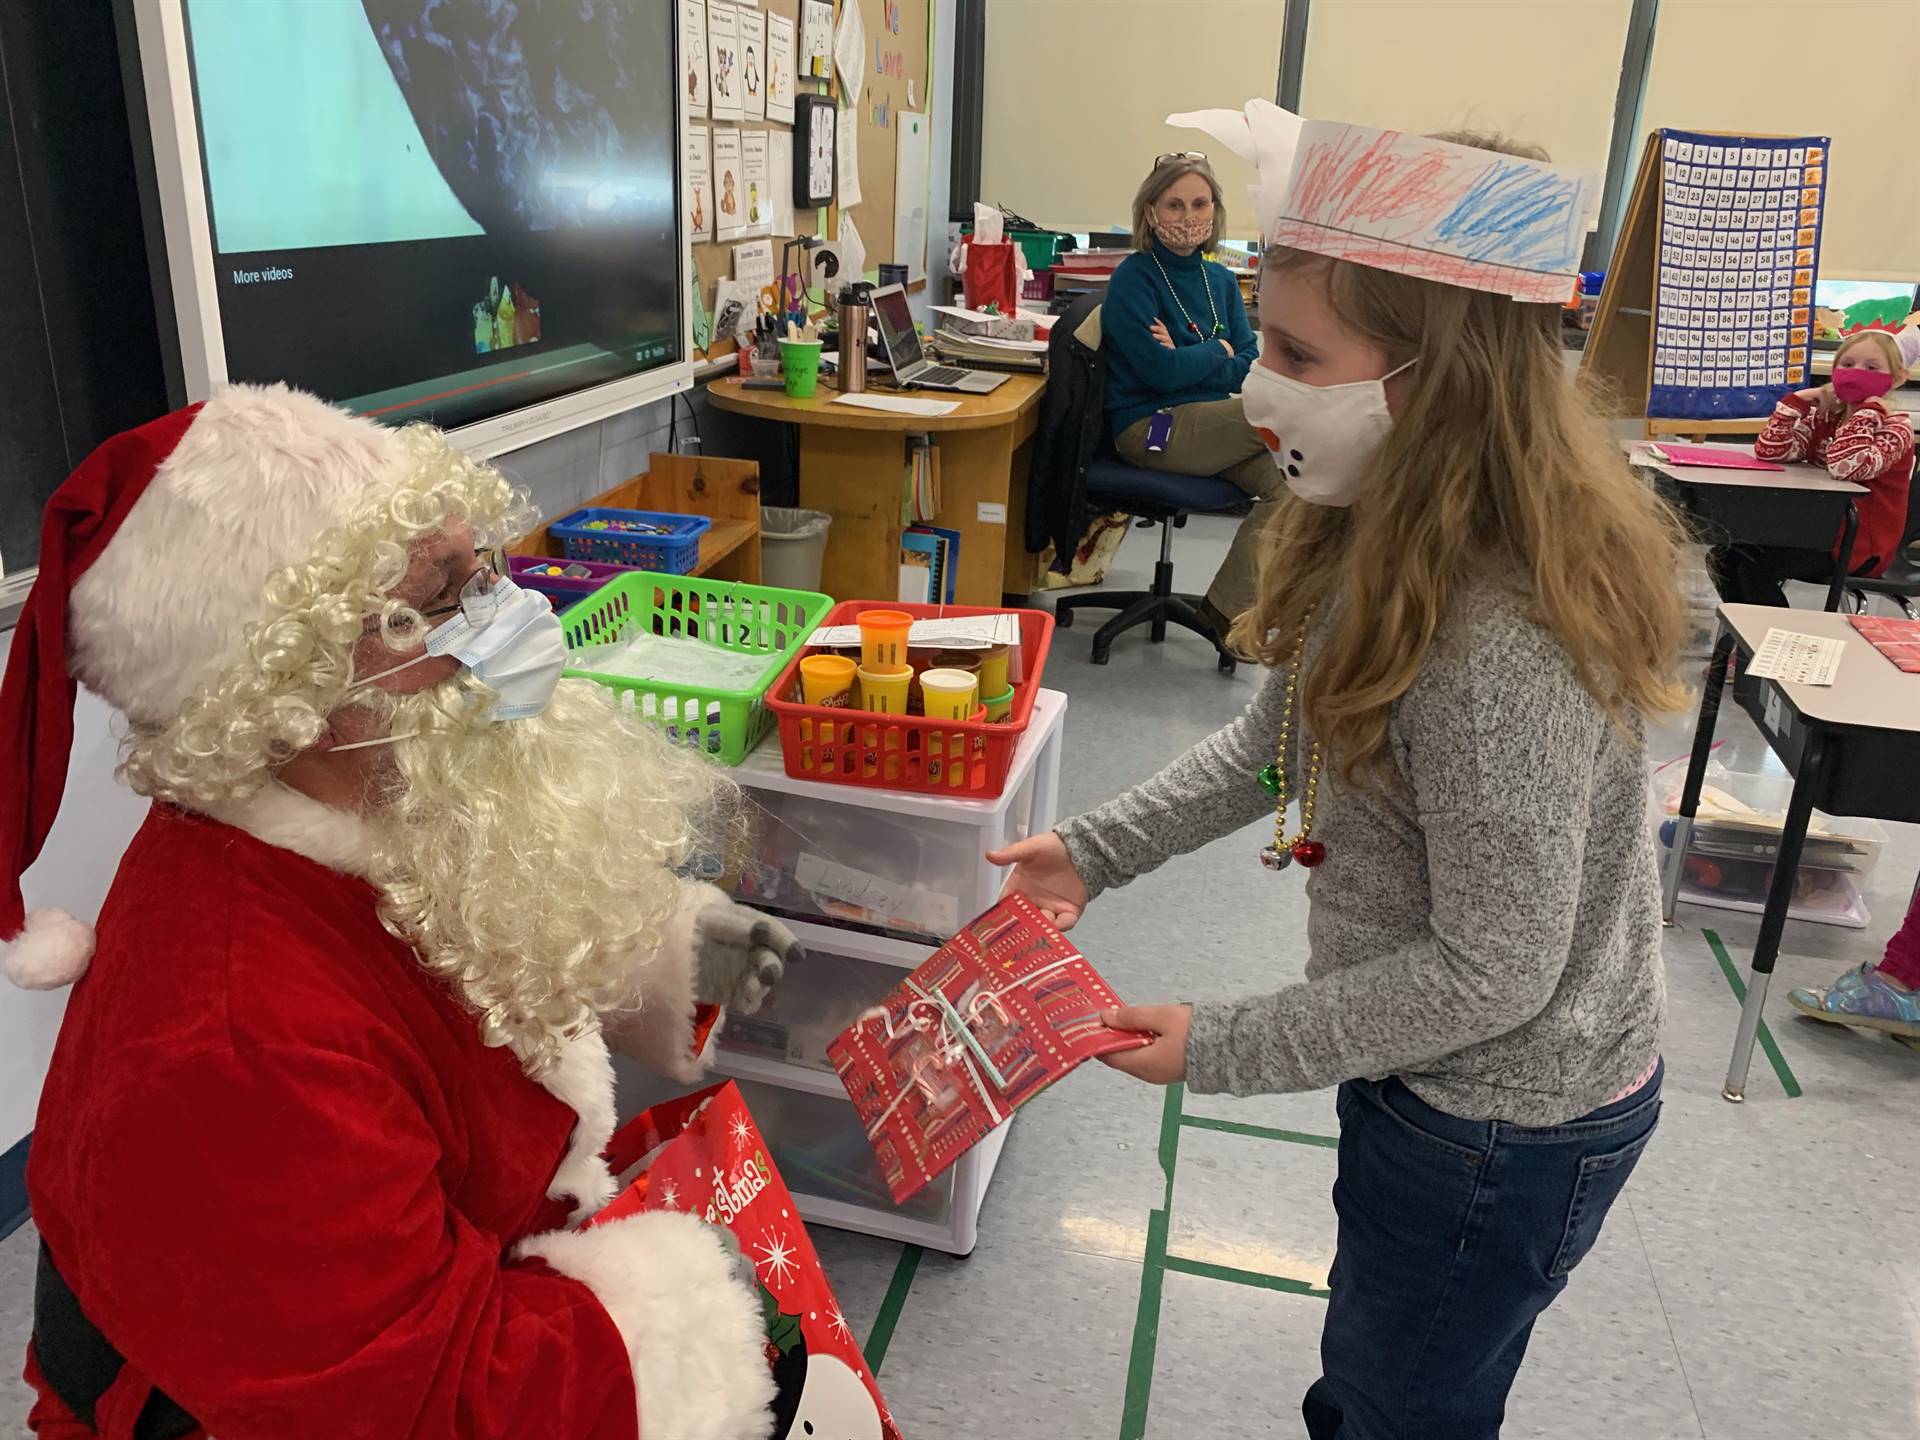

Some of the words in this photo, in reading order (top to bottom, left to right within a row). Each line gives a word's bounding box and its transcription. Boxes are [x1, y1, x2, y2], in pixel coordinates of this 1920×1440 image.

[1698, 150, 1703, 158] 3
[1730, 152, 1734, 160] 5
[1679, 169, 1686, 178] 12
[1694, 172, 1702, 180] 13
[1726, 174, 1732, 182] 15
[1758, 174, 1766, 183] 17
[1774, 174, 1781, 182] 18
[1807, 172, 1816, 182] 2
[1677, 190, 1686, 199] 22
[1690, 192, 1700, 201] 23
[1706, 193, 1715, 202] 24
[1721, 194, 1730, 203] 25
[1737, 196, 1746, 204] 26
[1752, 196, 1762, 204] 27
[1768, 195, 1777, 204] 28
[1785, 194, 1796, 202] 29
[1675, 211, 1683, 220] 32
[1688, 213, 1696, 221] 33
[1702, 214, 1712, 222] 34
[1718, 215, 1727, 224] 35
[1733, 215, 1742, 223] 36
[1750, 216, 1760, 224] 37
[1765, 215, 1774, 223] 38
[1782, 214, 1793, 223] 39
[1674, 231, 1682, 240] 42
[1686, 234, 1695, 242] 43
[1715, 236, 1724, 244] 45
[1762, 235, 1772, 243] 48
[1780, 234, 1791, 242] 49
[1672, 251, 1680, 260] 52
[1684, 253, 1693, 262] 53
[1698, 254, 1707, 262] 54
[1713, 256, 1722, 264] 55
[1728, 256, 1737, 264] 56
[1744, 256, 1753, 264] 57
[1760, 255, 1770, 264] 58
[1779, 254, 1790, 263] 59
[233, 270, 260, 284] More
[262, 266, 293, 281] videos
[1672, 273, 1678, 281] 62
[1682, 274, 1690, 282] 63
[1710, 275, 1720, 283] 65
[1742, 275, 1751, 283] 67
[1758, 274, 1768, 283] 68
[1777, 274, 1788, 282] 69
[1798, 272, 1809, 280] 70
[1681, 293, 1688, 302] 73
[1709, 295, 1716, 303] 75
[1724, 295, 1733, 304] 76
[1776, 293, 1786, 302] 79
[1680, 313, 1686, 321] 83
[1707, 315, 1716, 323] 85
[1722, 315, 1732, 323] 86
[1738, 315, 1748, 323] 87
[1774, 313, 1785, 321] 89
[1679, 334, 1686, 342] 93
[1706, 335, 1716, 343] 95
[1793, 331, 1806, 340] 100
[1678, 353, 1686, 362] 103
[1719, 354, 1730, 363] 106
[1752, 354, 1764, 362] 108
[1789, 370, 1802, 378] 120
[691, 1150, 772, 1225] ristmas
